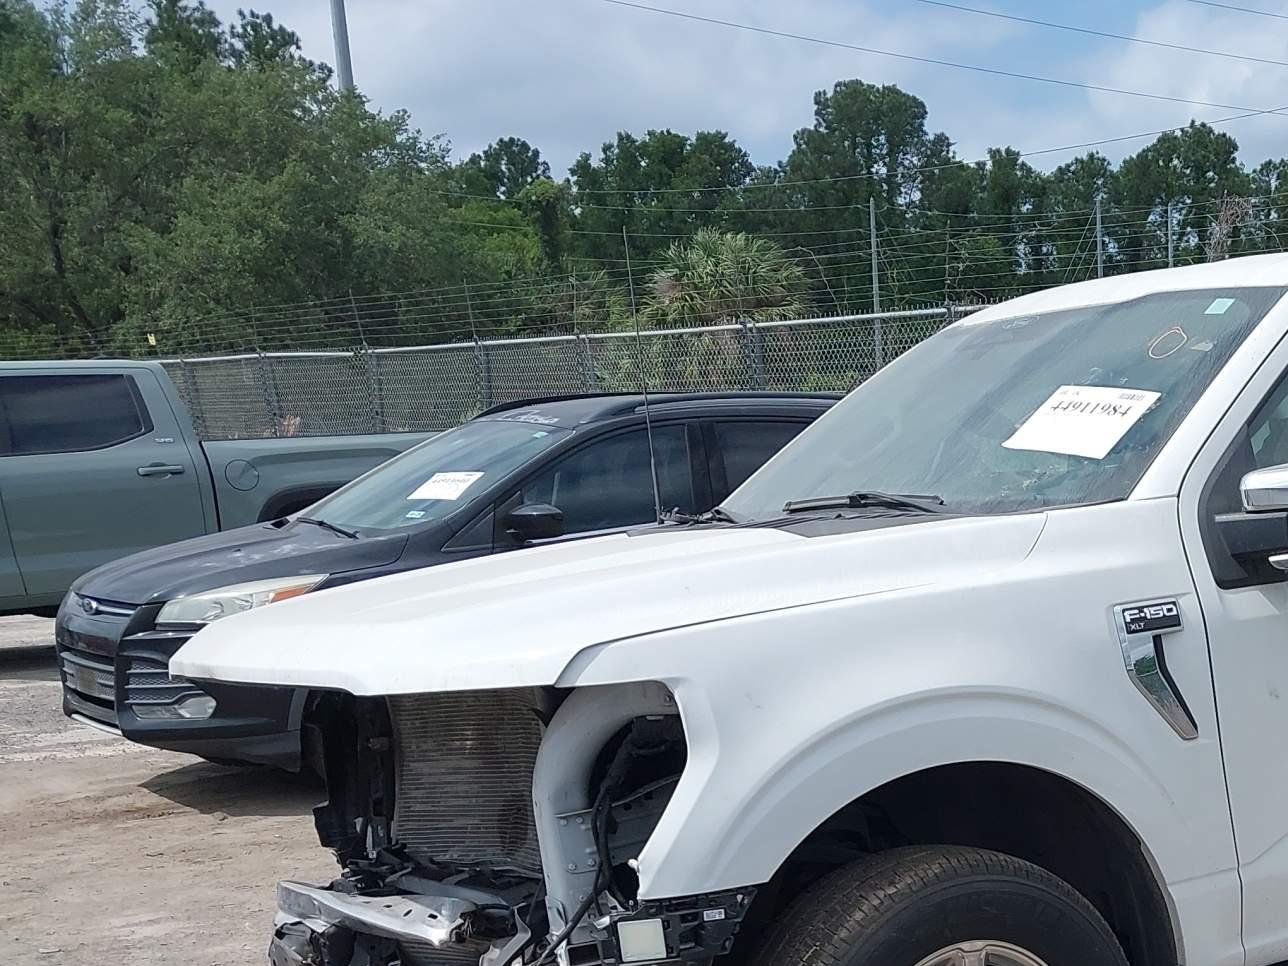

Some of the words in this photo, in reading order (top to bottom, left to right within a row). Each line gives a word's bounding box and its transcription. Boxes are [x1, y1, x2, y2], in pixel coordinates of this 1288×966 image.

[1051, 400, 1132, 417] 44911984
[1124, 604, 1178, 622] F-150
[1130, 622, 1145, 631] XLT
